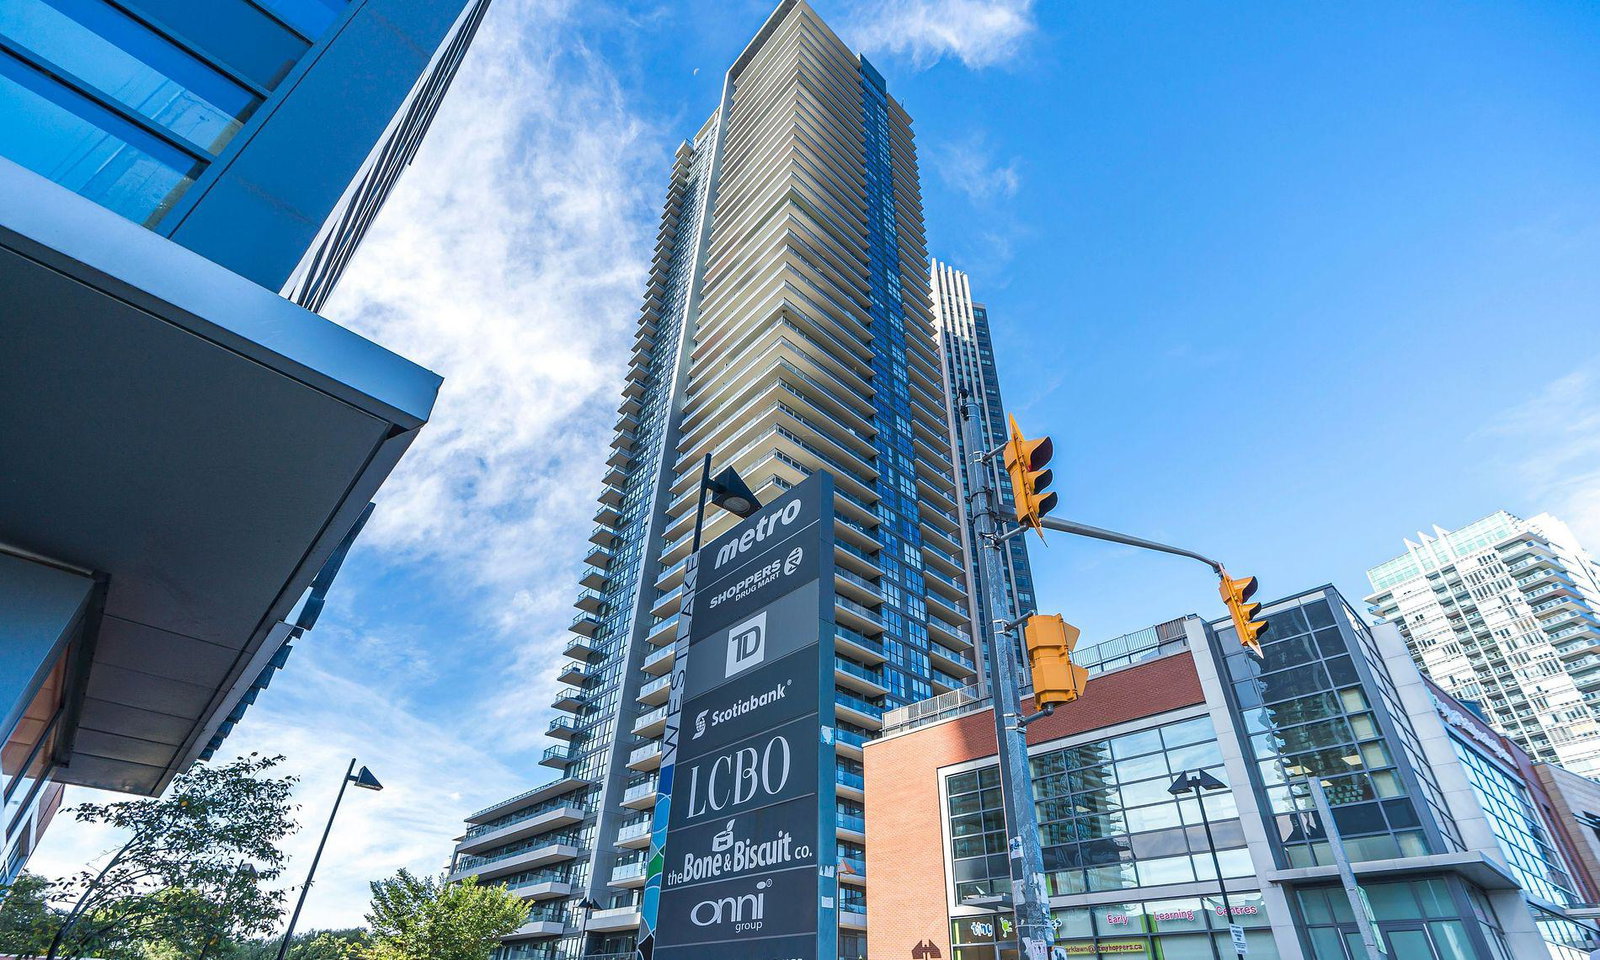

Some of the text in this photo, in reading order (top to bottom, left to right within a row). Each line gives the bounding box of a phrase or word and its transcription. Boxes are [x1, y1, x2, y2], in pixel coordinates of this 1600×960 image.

[714, 499, 802, 570] metro
[709, 559, 781, 609] SHOPPERS
[735, 570, 781, 602] DRUG MART
[662, 553, 700, 761] WESTLAKE
[731, 625, 762, 663] TD
[711, 683, 787, 727] Scotiabank
[686, 735, 791, 819] LCBO
[667, 867, 683, 886] the
[683, 852, 721, 883] Bone
[723, 855, 732, 872] &
[733, 830, 792, 873] Biscuit
[690, 880, 767, 927] onni
[1106, 912, 1128, 925] Early
[1153, 908, 1194, 921] Learning
[735, 920, 763, 933] group
[971, 922, 993, 937] tiny
